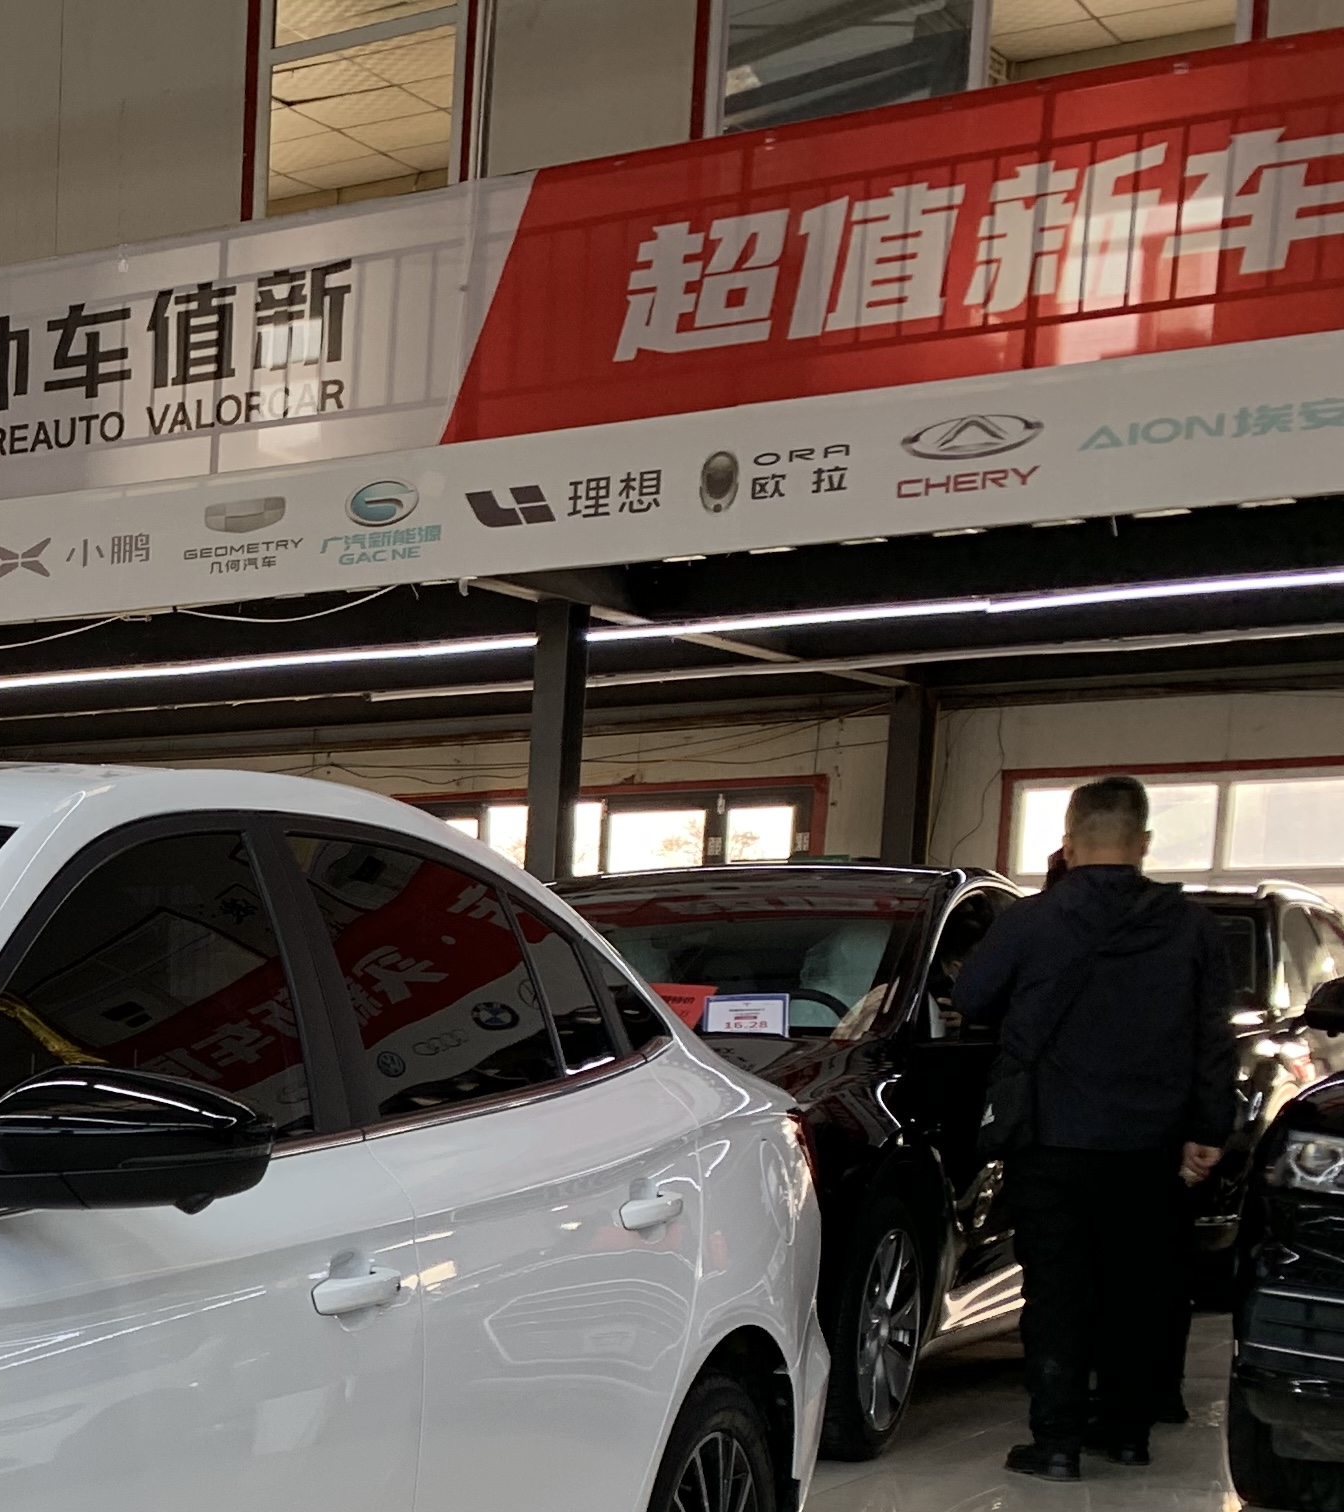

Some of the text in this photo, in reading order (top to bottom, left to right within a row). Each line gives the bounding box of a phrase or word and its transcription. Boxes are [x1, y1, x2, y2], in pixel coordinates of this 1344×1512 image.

[612, 126, 1344, 362] 超值新车
[1077, 412, 1226, 452] AION
[753, 444, 850, 466] ORA
[567, 469, 663, 519] 理想
[751, 466, 849, 501] 欧拉
[897, 465, 1041, 500] CHERY
[66, 532, 152, 568] 小鹏
[183, 537, 304, 561] GEOMETRY
[320, 524, 443, 555] 广汽新能源
[338, 547, 385, 567] GAC
[210, 555, 278, 575] 几何汽车
